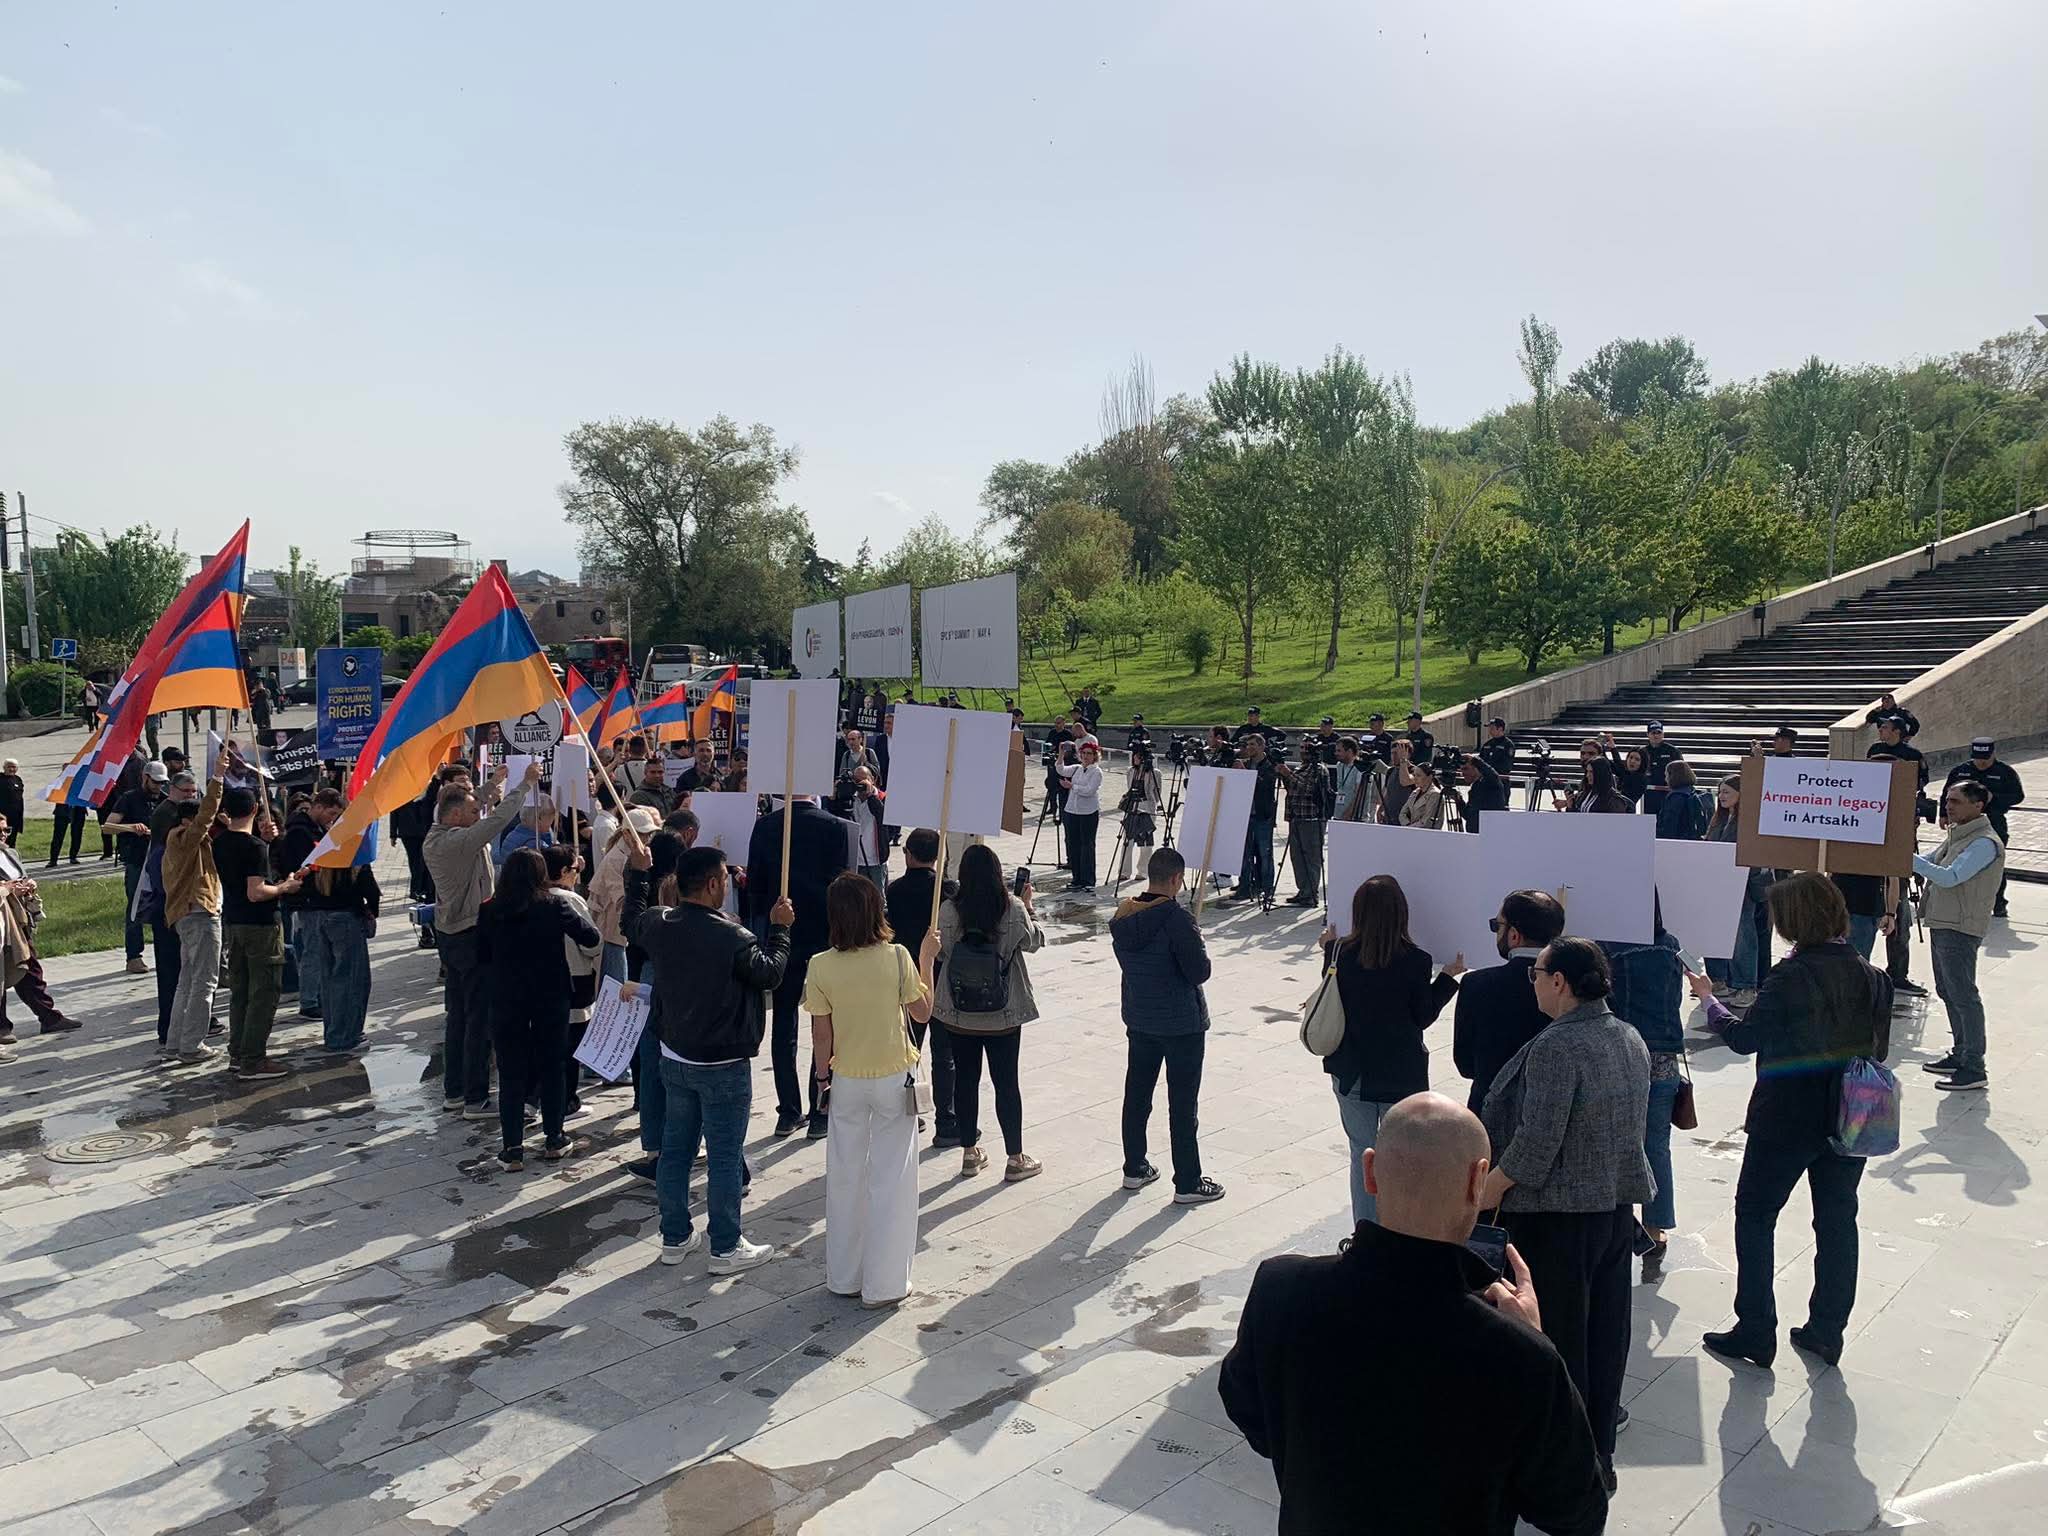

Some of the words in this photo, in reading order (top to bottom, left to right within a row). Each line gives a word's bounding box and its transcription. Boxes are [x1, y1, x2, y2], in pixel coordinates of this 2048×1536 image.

[328, 696, 345, 704] FOR
[345, 694, 372, 703] HUMAN
[328, 705, 372, 719] RIGHTS
[858, 707, 878, 717] FREE
[857, 715, 877, 725] LEVON
[514, 730, 552, 743] ALLIANCE
[709, 729, 728, 739] REE
[488, 743, 504, 754] REE
[1797, 773, 1854, 788] Protect
[1763, 790, 1832, 806] Armenian
[1838, 795, 1886, 813] legacy
[1784, 810, 1797, 822] in
[1802, 812, 1859, 827] Artsakh
[613, 1053, 623, 1067] bury
[620, 1040, 628, 1054] their
[626, 1023, 635, 1039] loved
[602, 1051, 615, 1070] Every
